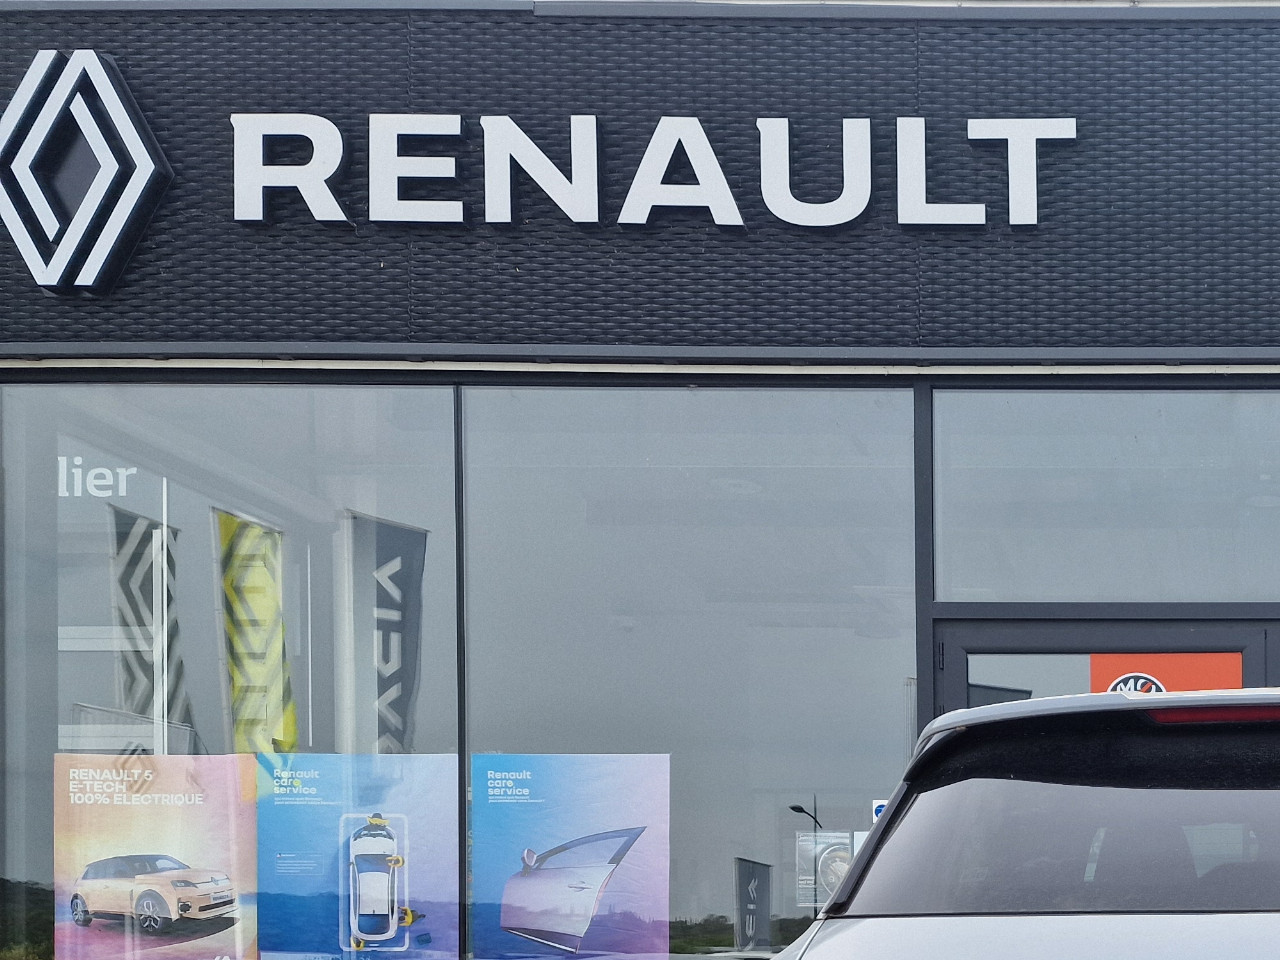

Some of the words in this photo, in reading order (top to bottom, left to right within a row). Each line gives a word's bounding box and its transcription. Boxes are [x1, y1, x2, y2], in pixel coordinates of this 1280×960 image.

[230, 113, 1077, 226] RENAULT
[57, 456, 137, 497] lier
[69, 769, 141, 781] RENAULT
[144, 771, 153, 781] 5
[273, 769, 320, 779] Renault
[487, 770, 532, 779] Renault
[69, 781, 127, 793] E-TECH
[273, 778, 302, 787] care
[273, 786, 317, 794] service
[487, 787, 530, 795] service
[69, 793, 110, 805] 100%
[113, 793, 204, 806] ELECTRIQUE
